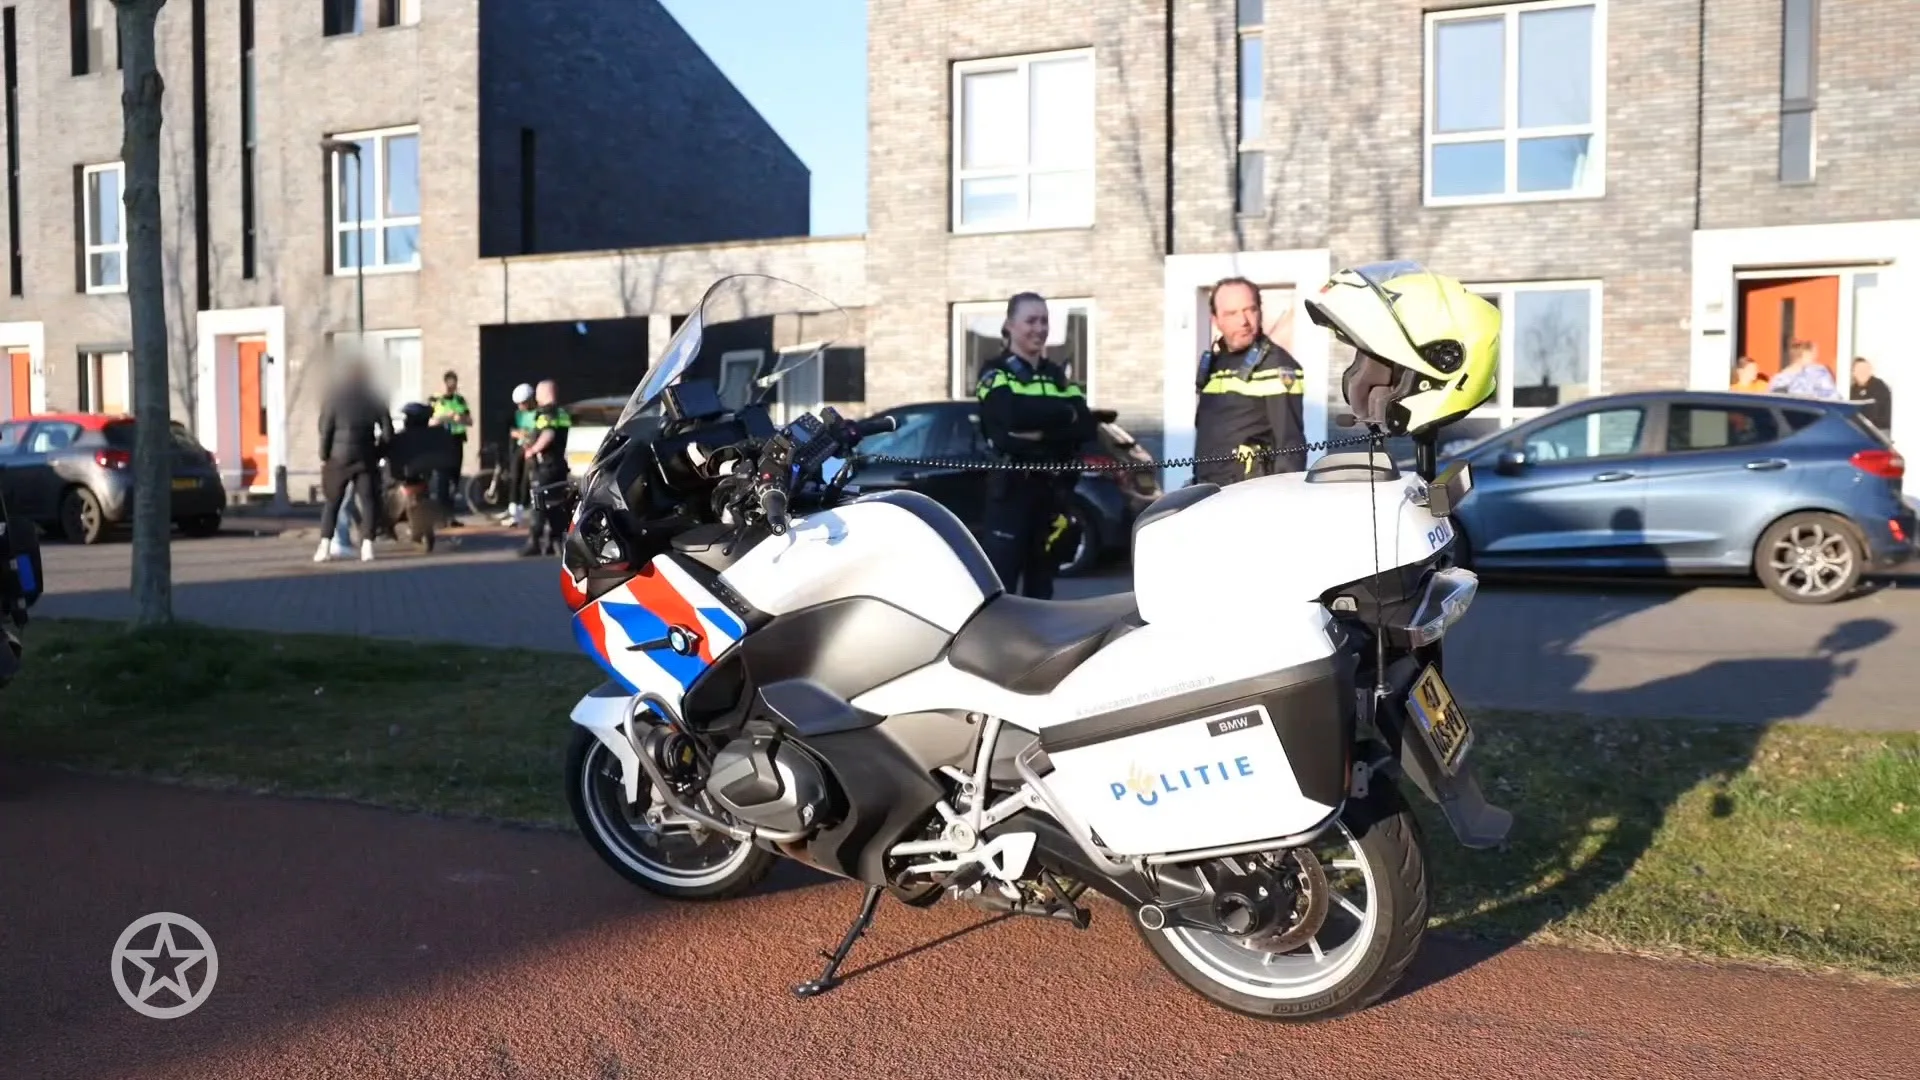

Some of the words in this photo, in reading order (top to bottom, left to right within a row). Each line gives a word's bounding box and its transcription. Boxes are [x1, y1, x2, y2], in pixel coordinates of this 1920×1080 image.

[1219, 716, 1248, 732] BMW
[1110, 755, 1254, 806] POLITIE
[1276, 1004, 1291, 1013] GT
[1302, 995, 1331, 1011] ROAD
